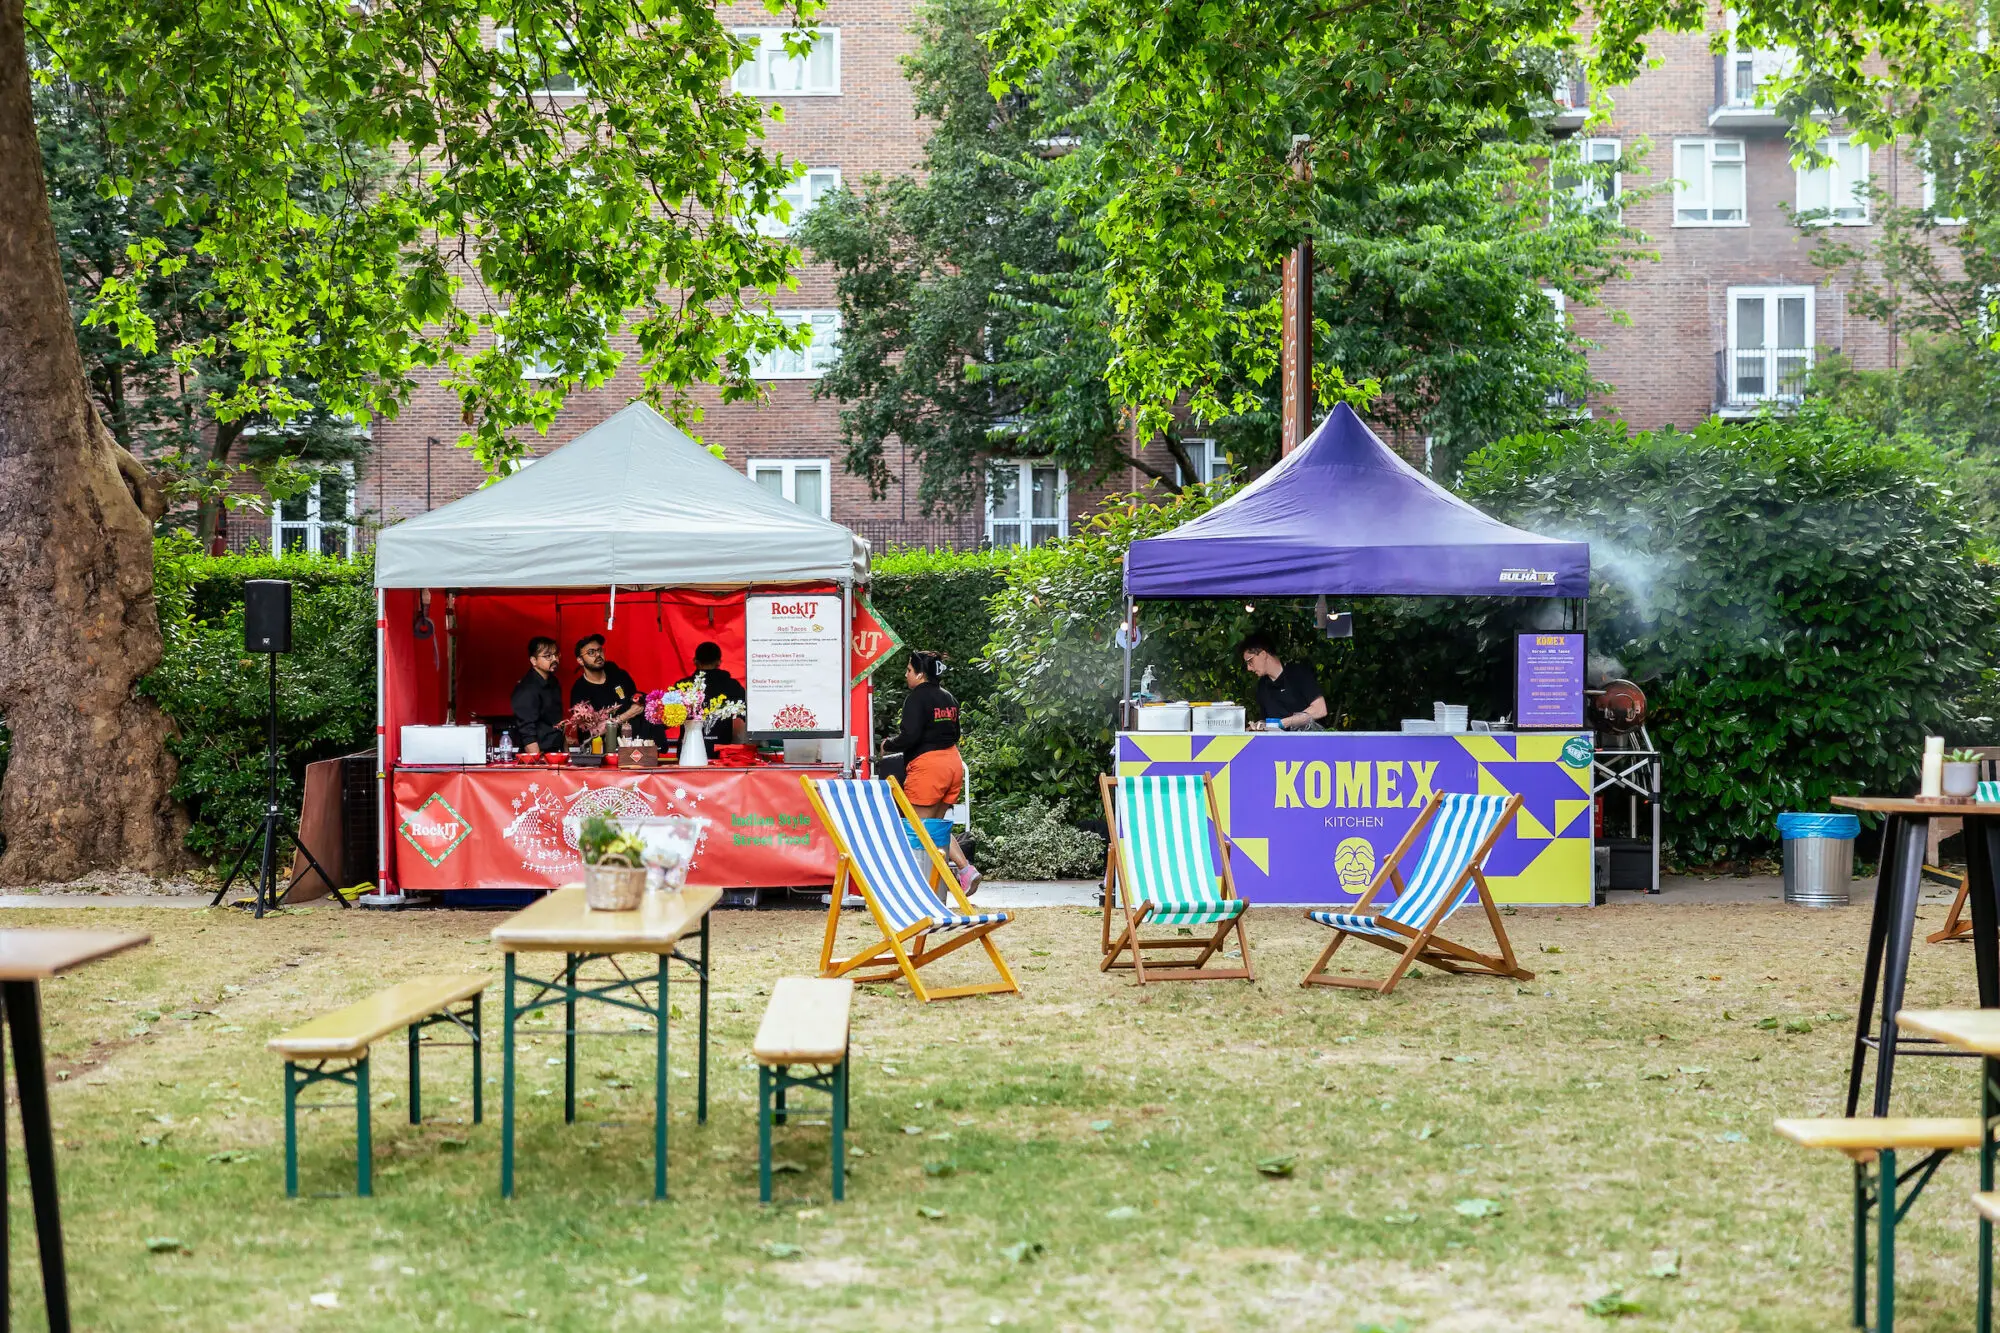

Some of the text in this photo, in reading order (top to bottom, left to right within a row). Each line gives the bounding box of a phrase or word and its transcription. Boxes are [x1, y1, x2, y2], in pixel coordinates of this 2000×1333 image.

[1499, 569, 1558, 583] BULHAWK
[771, 602, 819, 620] RockIT
[1536, 636, 1565, 646] KOMEX
[1274, 760, 1440, 808] KOMEX
[731, 812, 811, 829] Indian Style
[1324, 816, 1384, 828] KITCHEN
[412, 822, 459, 841] RockIT
[732, 832, 810, 847] Street Food
